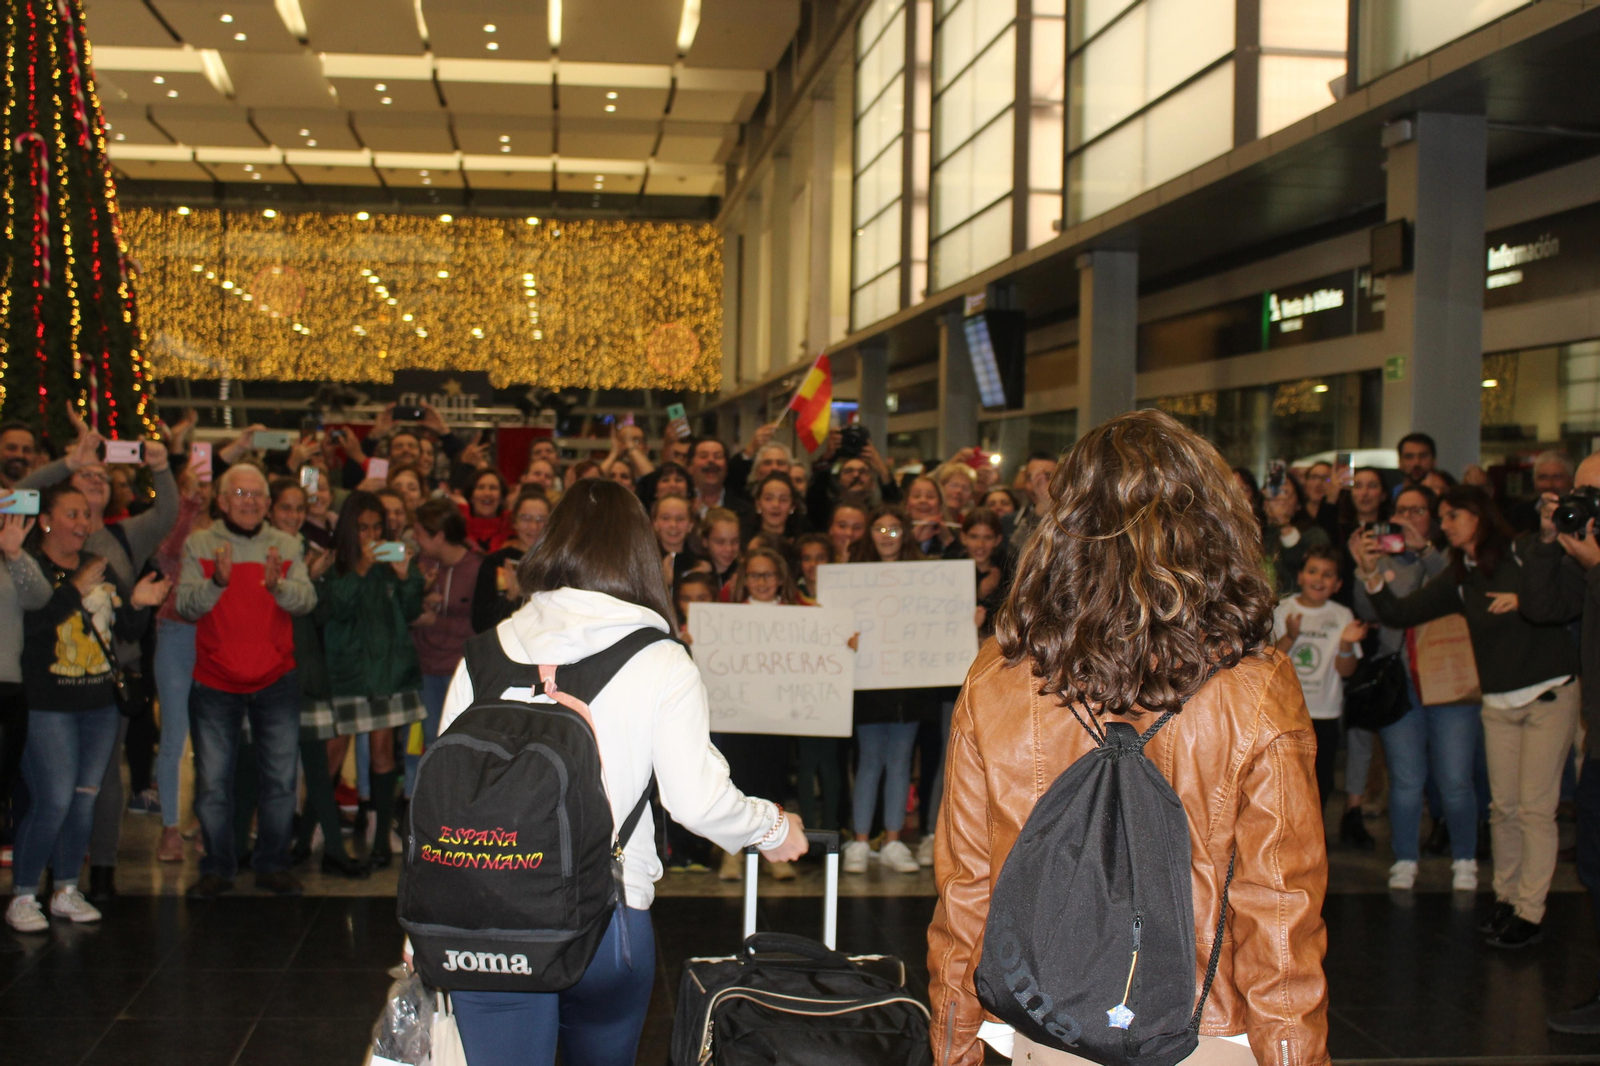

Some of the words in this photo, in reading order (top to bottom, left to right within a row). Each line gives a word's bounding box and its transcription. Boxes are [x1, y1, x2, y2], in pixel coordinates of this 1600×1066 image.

[827, 563, 957, 589] ILUSIÓN
[695, 608, 847, 647] Bienvenidas
[857, 617, 960, 644] PLATA
[706, 649, 844, 677] GUERRERAS
[853, 648, 973, 676] UERRERA
[708, 680, 751, 705] OLE
[776, 681, 842, 705] MARTA
[438, 825, 519, 847] ESPAÑA
[421, 844, 544, 870] BALONMANO
